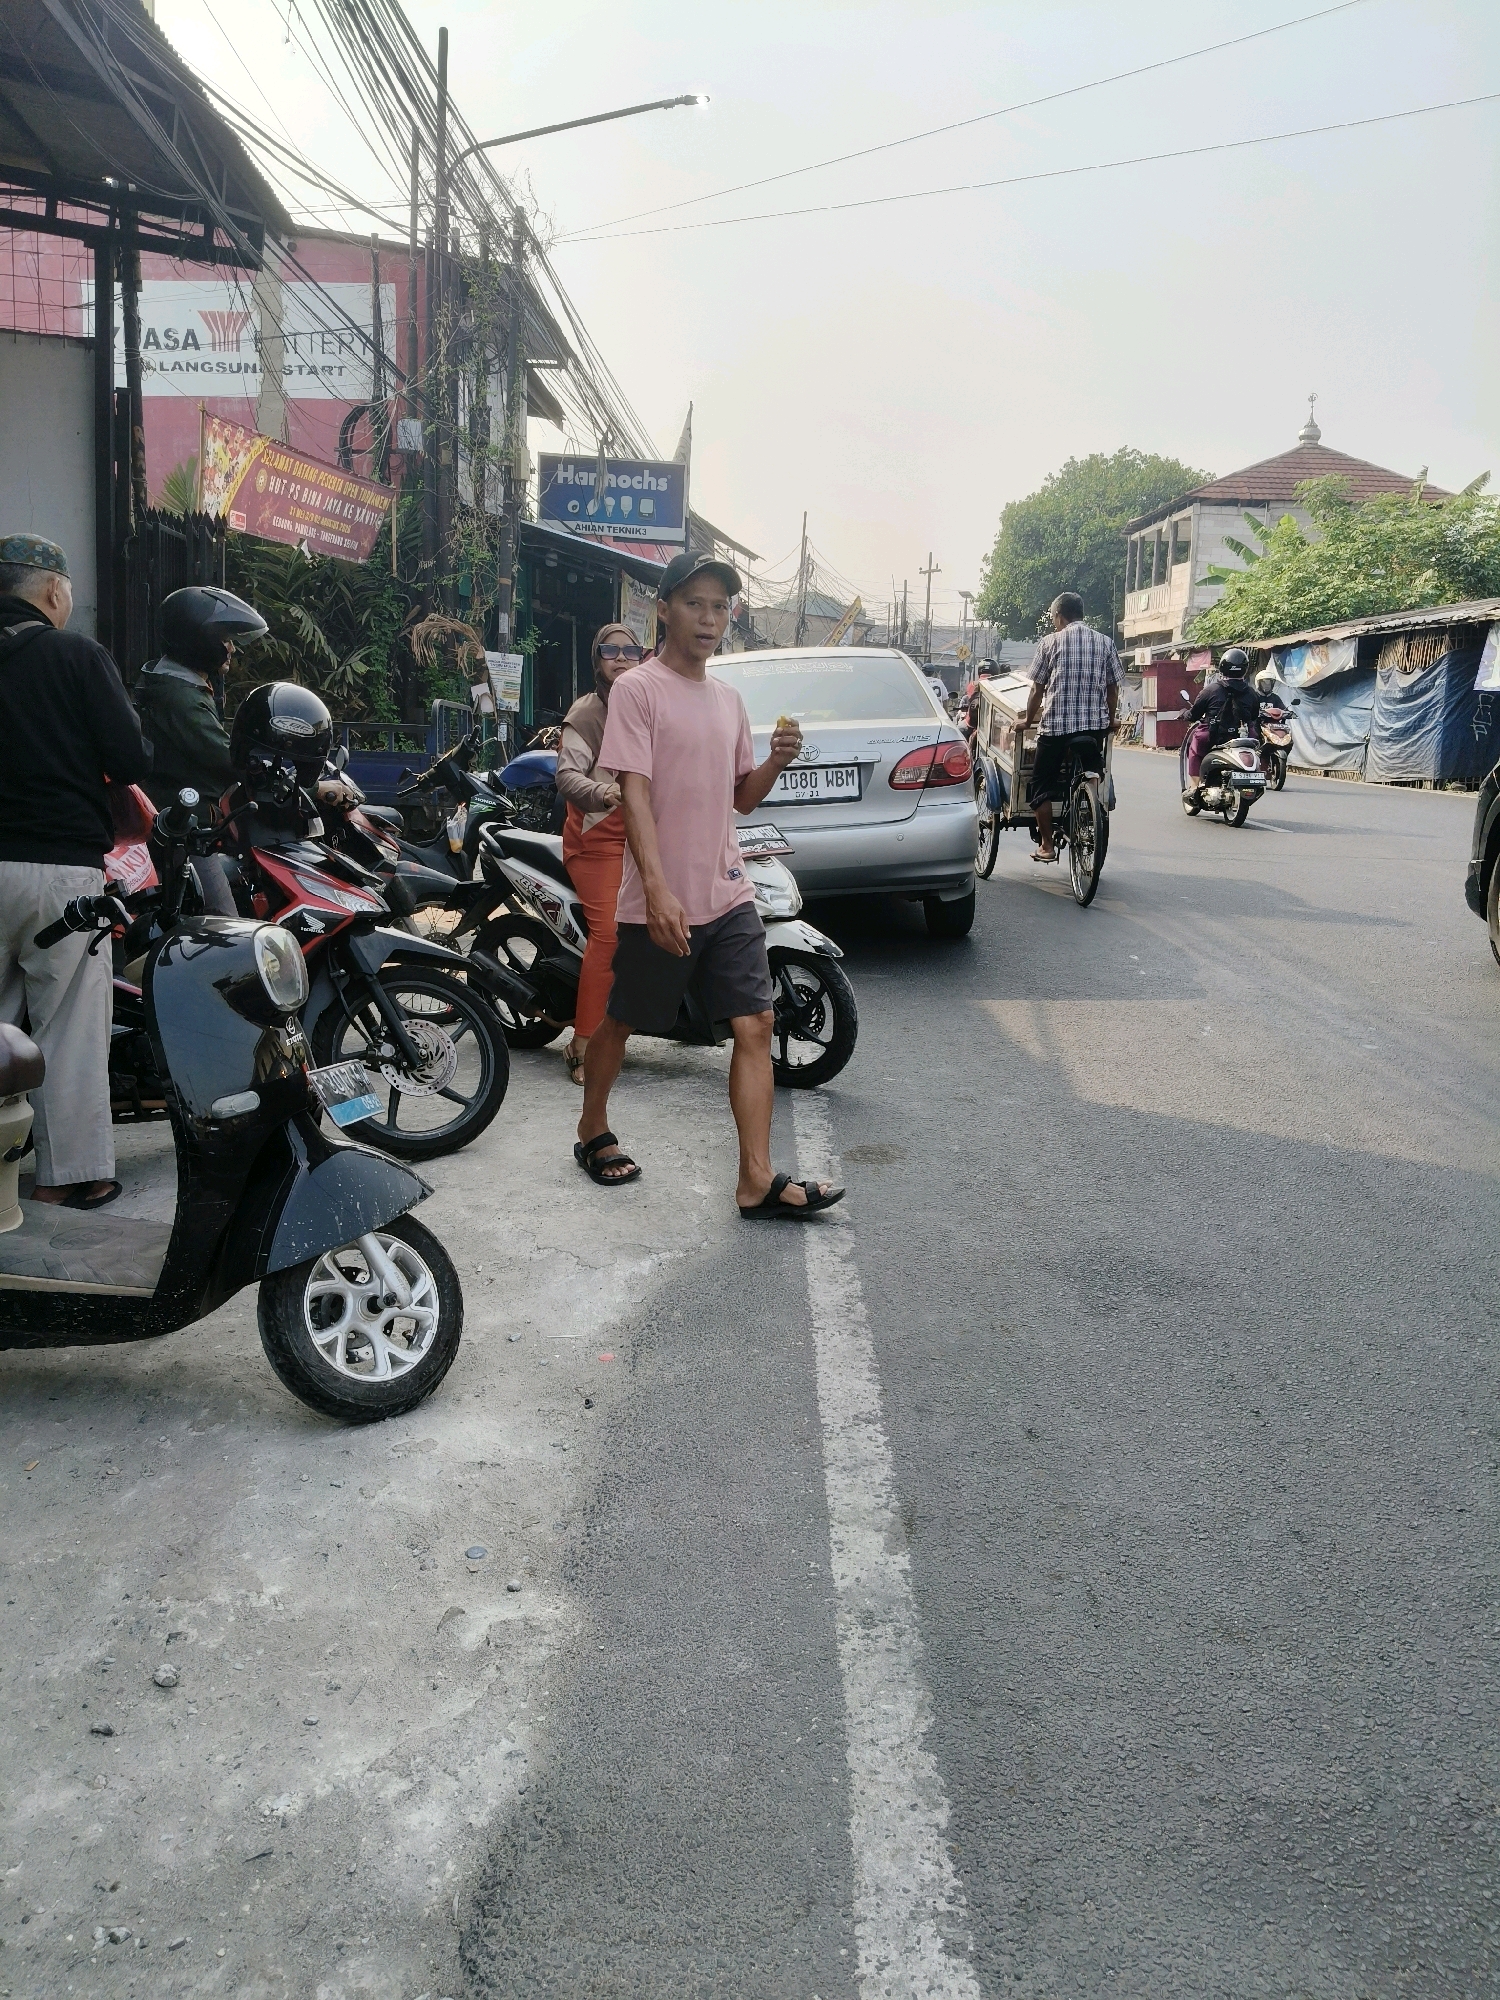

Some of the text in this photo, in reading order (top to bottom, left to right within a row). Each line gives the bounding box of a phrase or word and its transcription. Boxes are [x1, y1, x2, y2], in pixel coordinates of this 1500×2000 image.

[113, 327, 200, 351] ASA
[159, 361, 345, 377] LANGSUN START
[261, 449, 292, 473] SELAMAT
[293, 461, 318, 482] DATANG
[317, 471, 344, 493] PESERTA
[342, 482, 359, 500] OPEN
[269, 475, 287, 495] HUT
[288, 482, 301, 501] PS
[301, 487, 323, 509] BINA
[322, 496, 343, 516] JAYA
[342, 502, 355, 519] KE
[575, 523, 605, 533] AHIAN
[779, 769, 855, 791] 1080 WBM
[474, 796, 497, 806] HONDA
[112, 845, 149, 880] YAKUL
